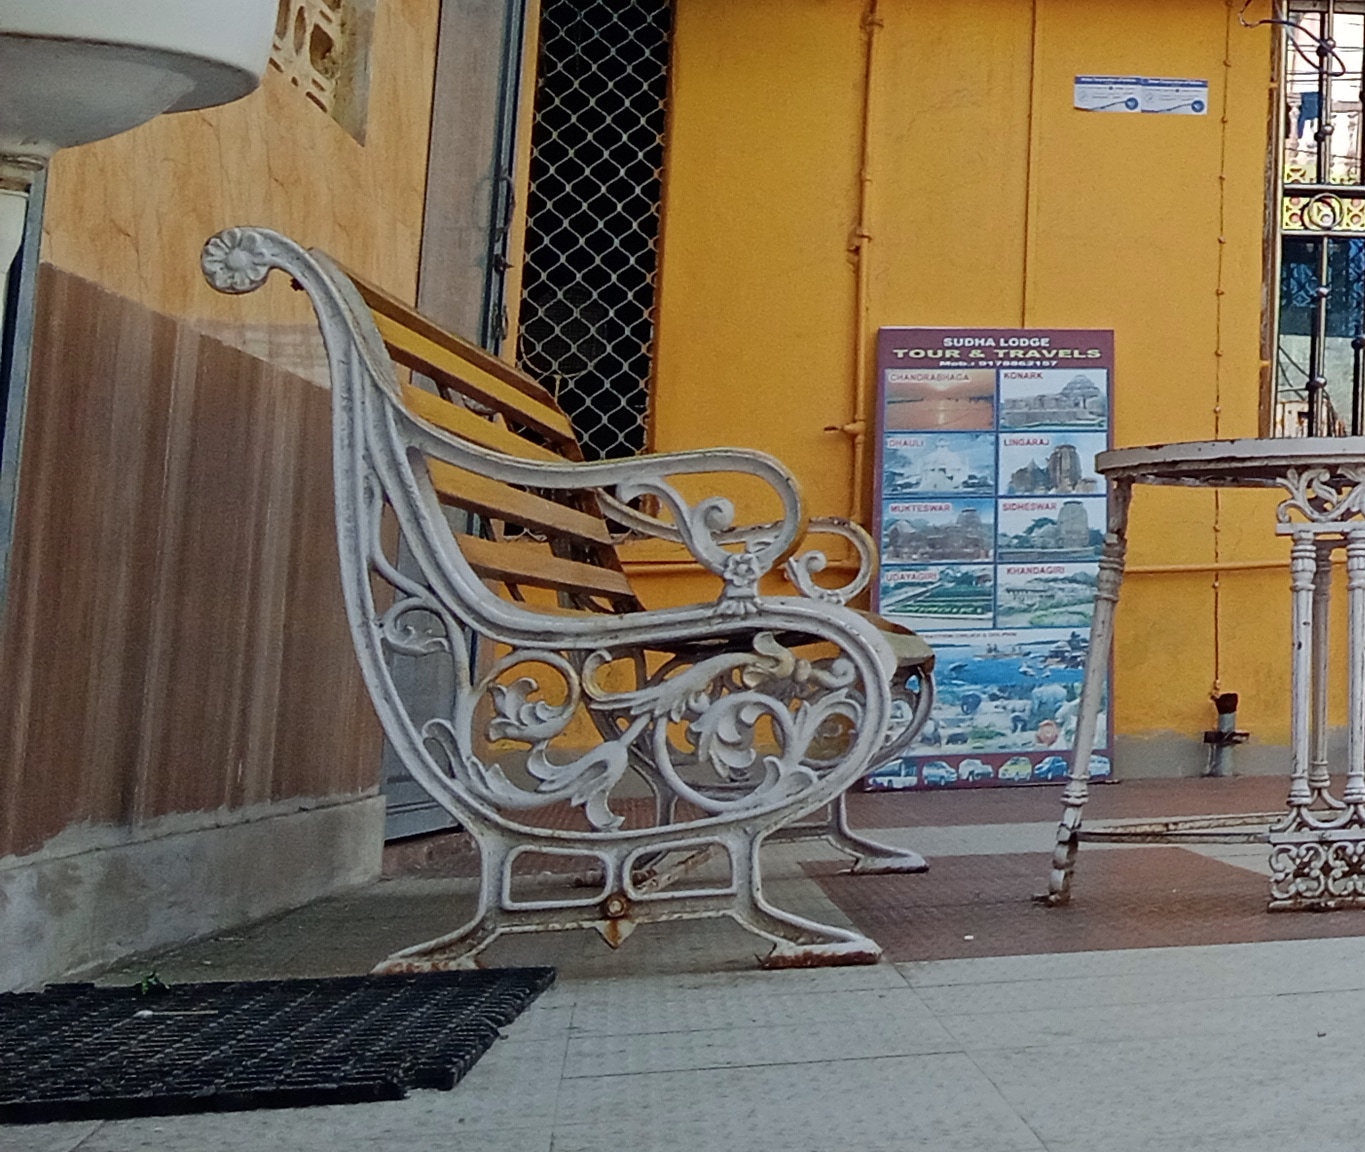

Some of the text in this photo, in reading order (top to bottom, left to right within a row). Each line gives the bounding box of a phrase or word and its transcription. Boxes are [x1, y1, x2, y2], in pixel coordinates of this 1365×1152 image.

[943, 337, 1050, 347] SUDHA LODGE
[893, 349, 1101, 359] TOUR & TRAVELS
[890, 373, 969, 382] CHANDRABHAGA
[1003, 371, 1043, 380] KONARK
[1003, 437, 1049, 446] LINGARAJ
[890, 503, 951, 513] MUKTESWAR
[1002, 502, 1057, 511] SIDHESWAR
[1006, 566, 1065, 575] KHANDAGIRI
[885, 571, 937, 582] UDAYAGIRI
